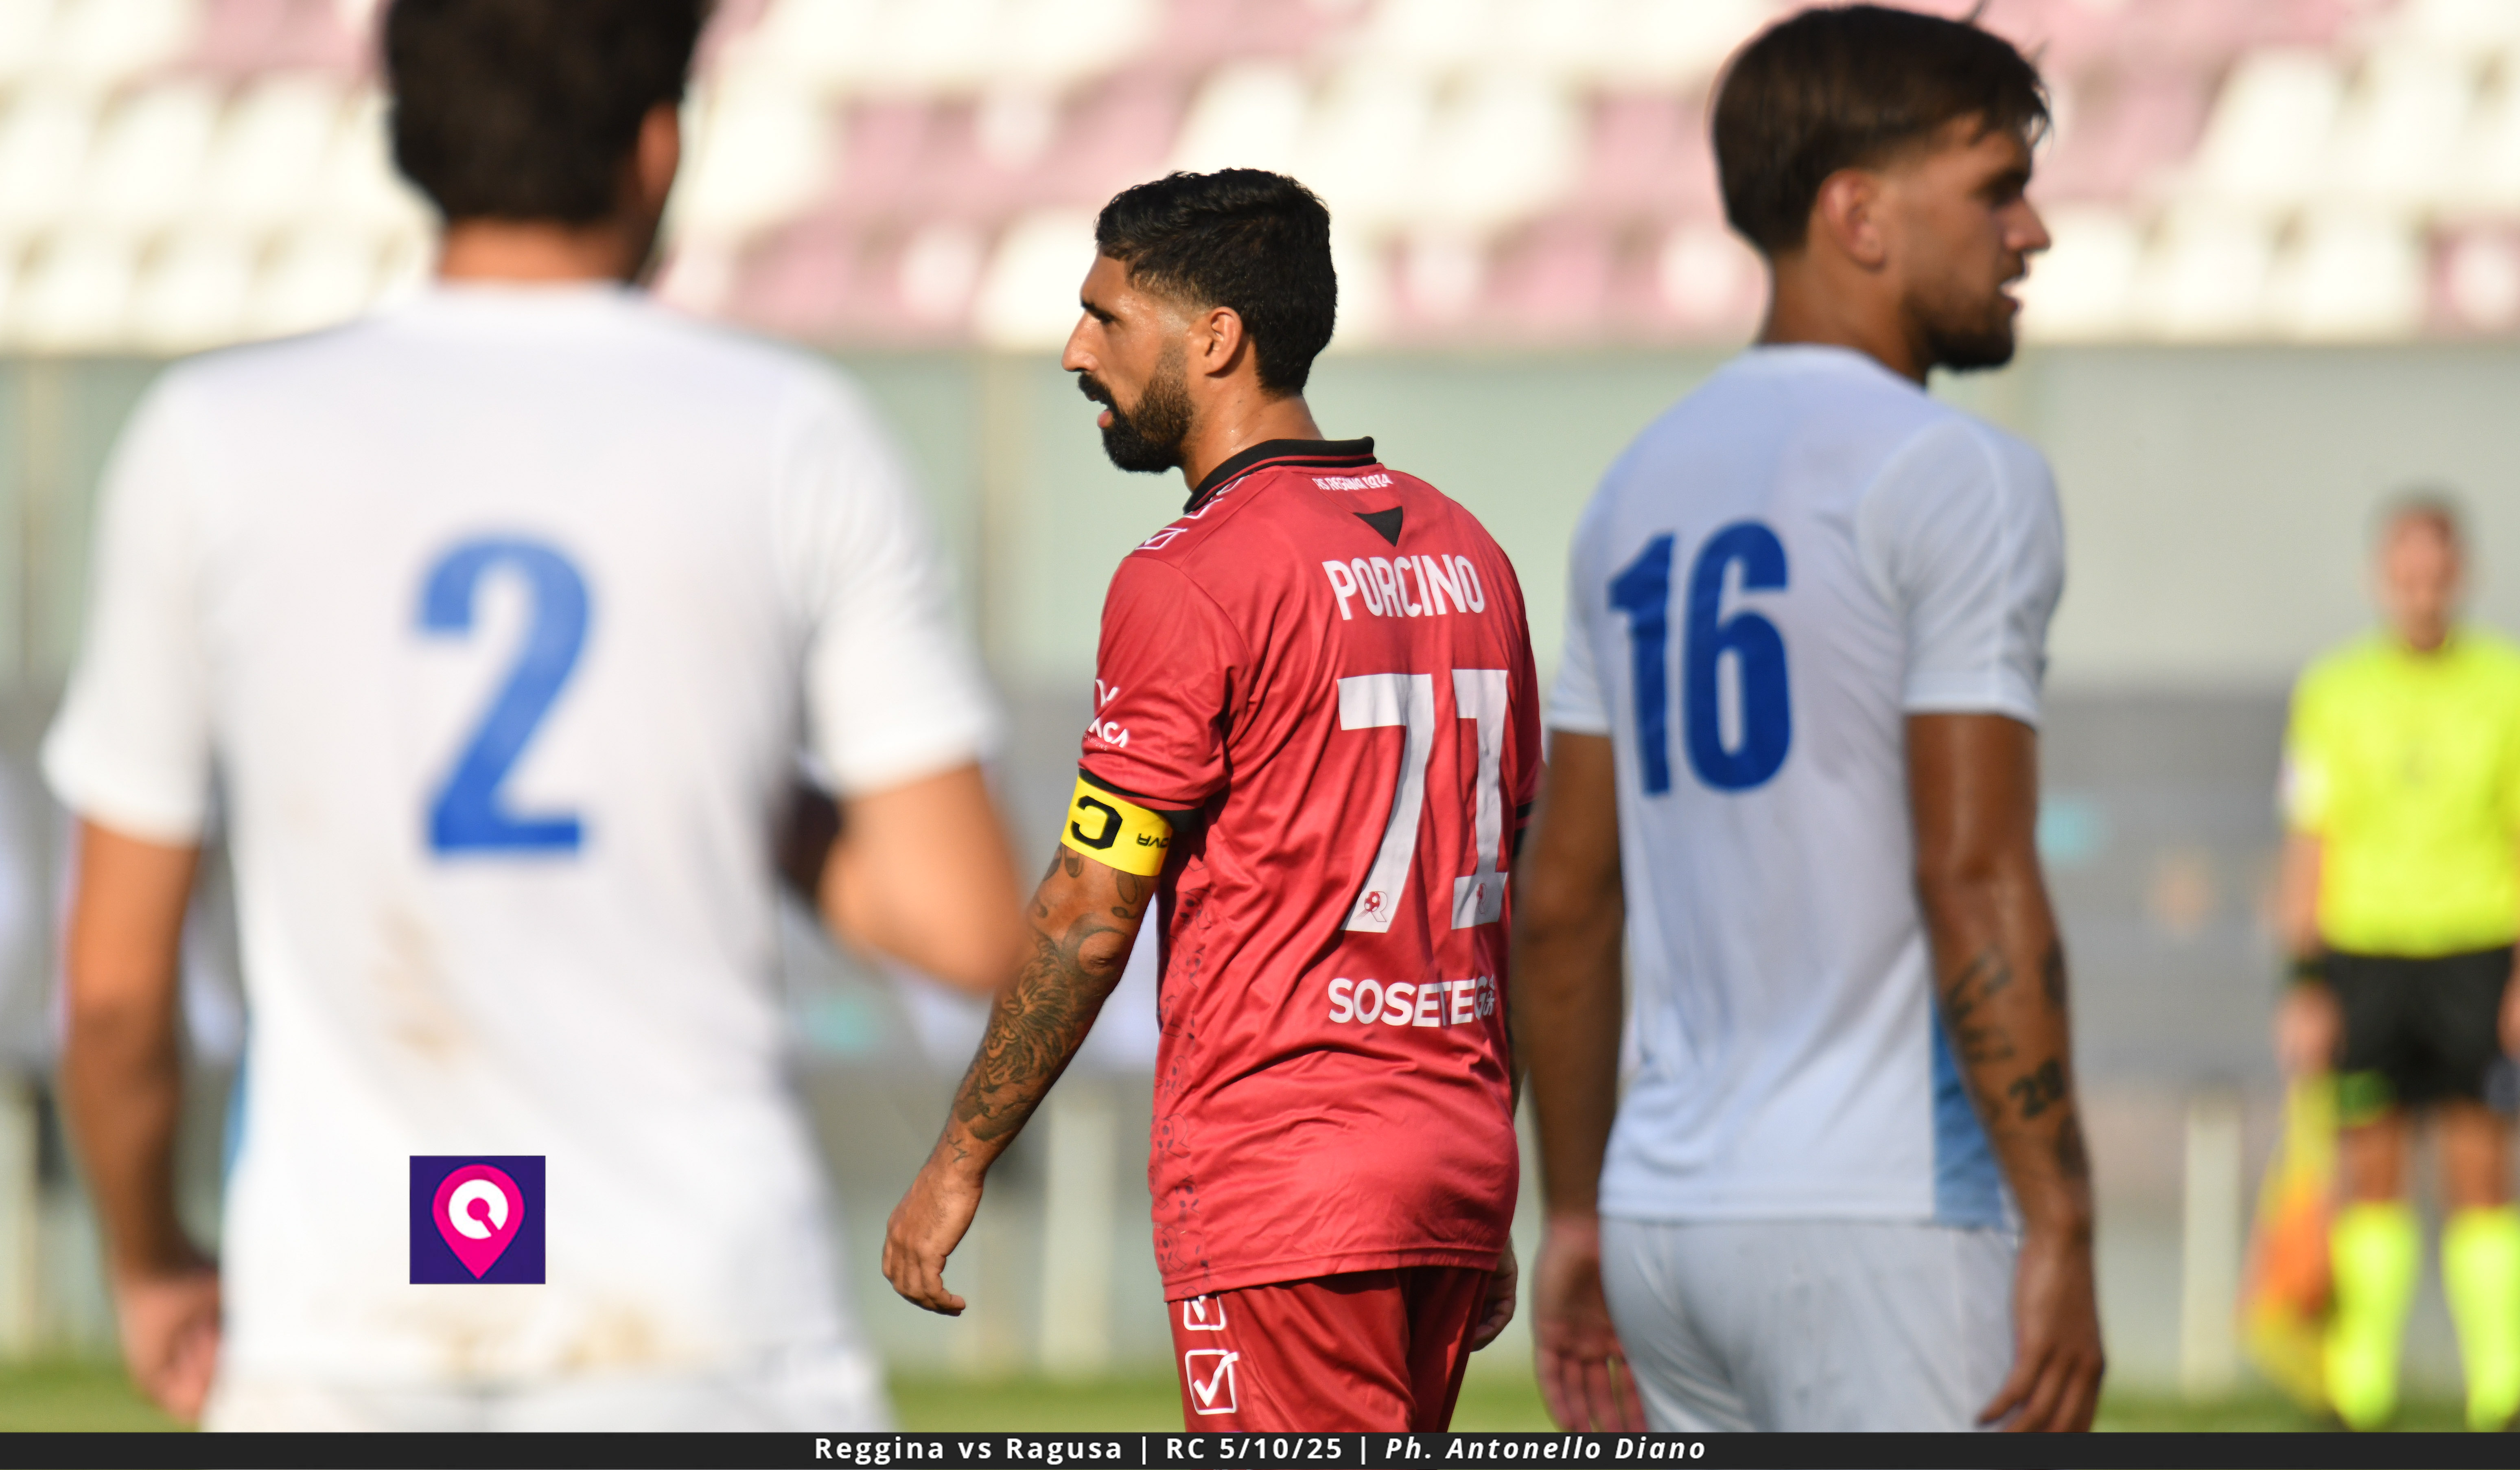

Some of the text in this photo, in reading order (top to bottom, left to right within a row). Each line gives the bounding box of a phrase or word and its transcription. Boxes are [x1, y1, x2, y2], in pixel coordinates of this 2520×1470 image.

[1361, 473, 1393, 489] 1914
[1321, 554, 1485, 621] PORCINO
[1608, 519, 1793, 797] 16
[420, 533, 592, 857] 2
[1070, 795, 1123, 850] C
[1337, 669, 1509, 933] 71
